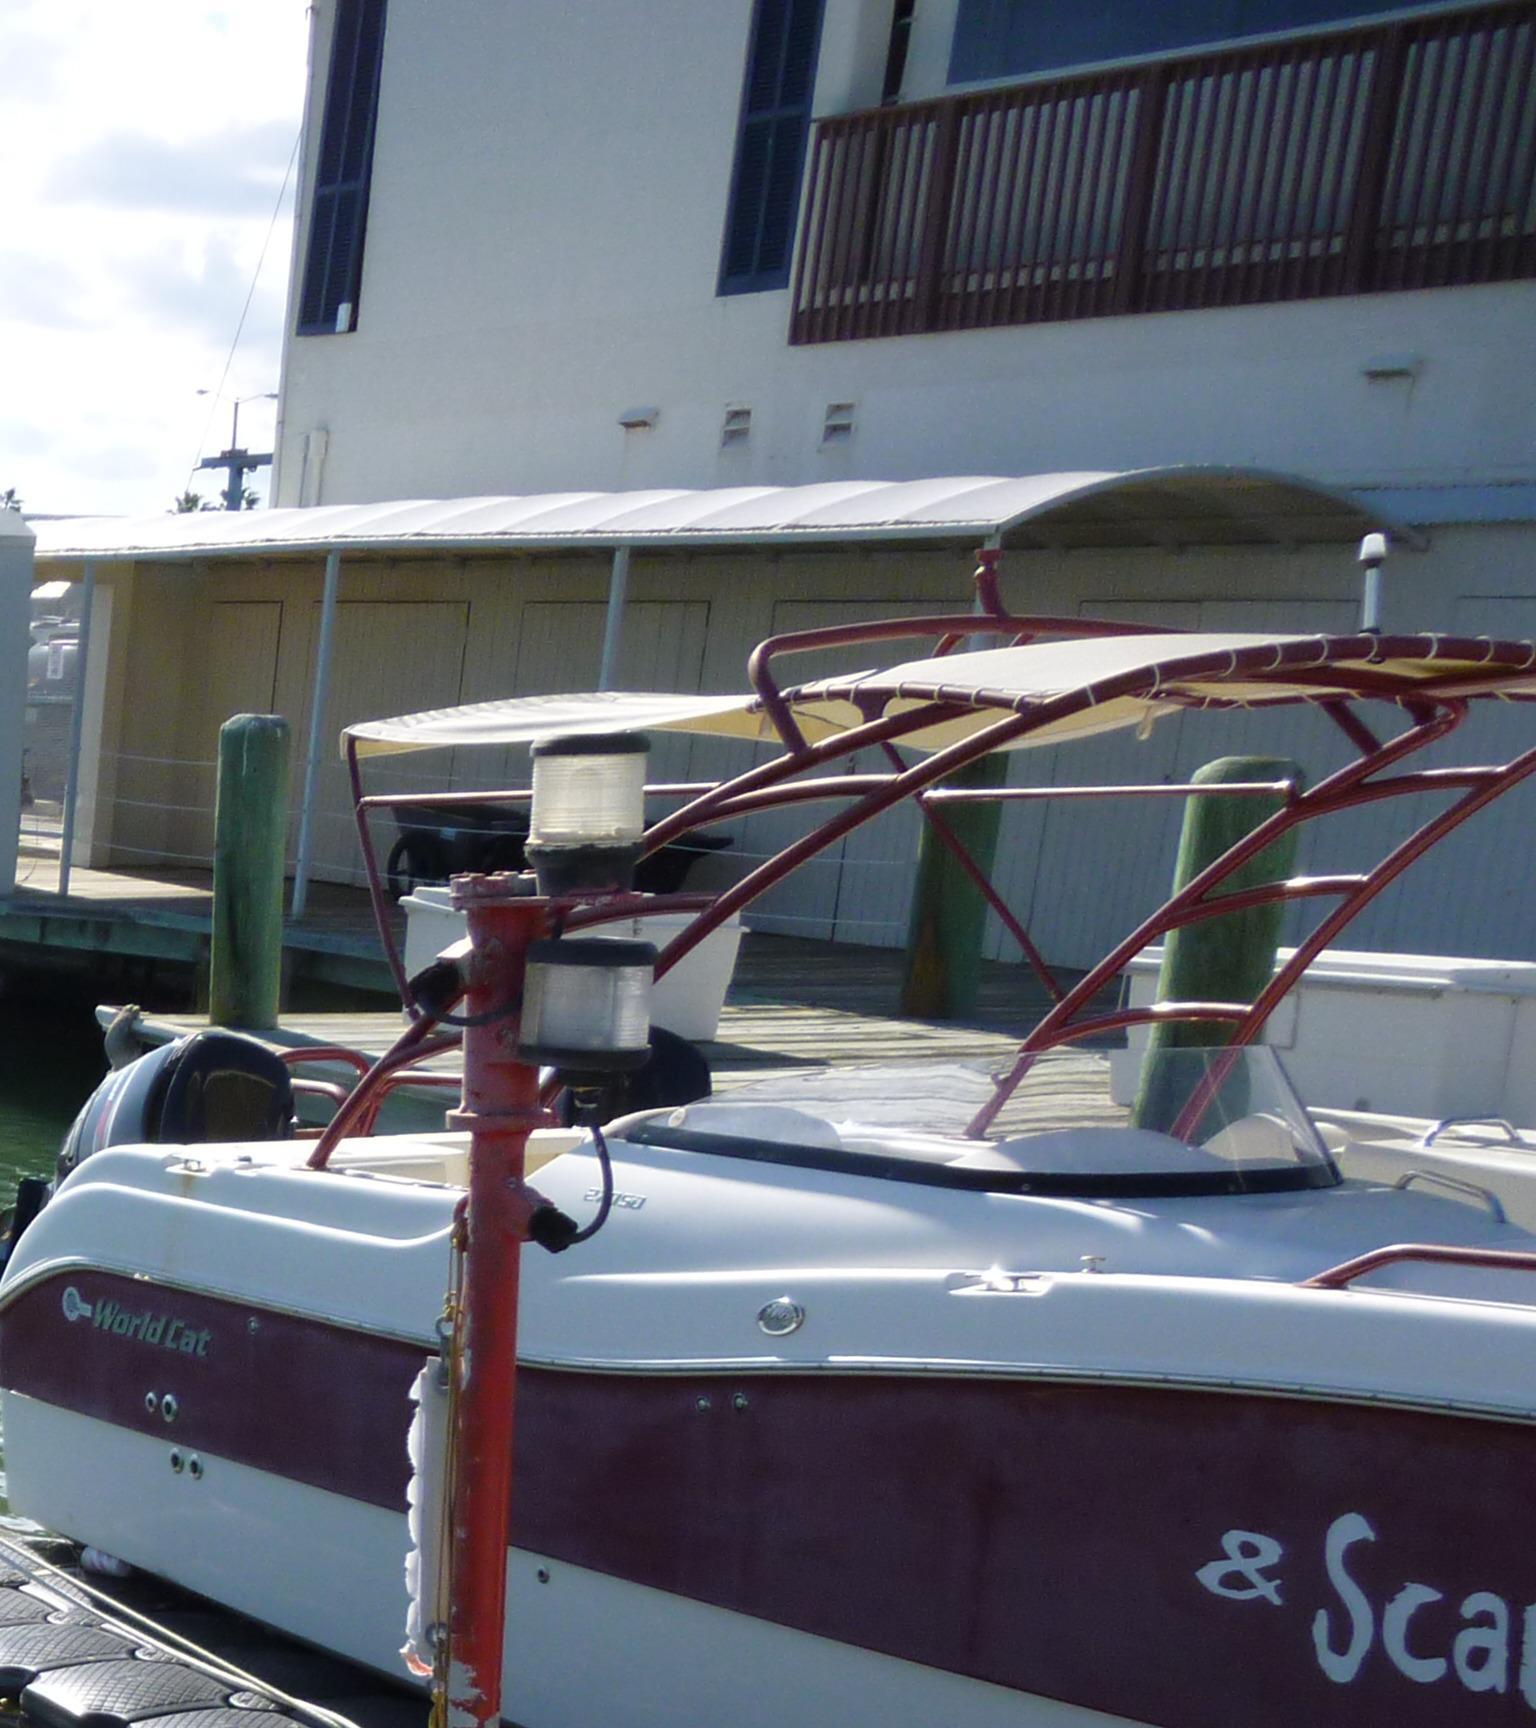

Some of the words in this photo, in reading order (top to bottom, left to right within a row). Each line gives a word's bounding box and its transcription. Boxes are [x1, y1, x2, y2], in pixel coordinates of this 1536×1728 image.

[93, 1299, 168, 1345] World
[163, 1315, 212, 1357] Cat
[1194, 1529, 1283, 1606] &
[1312, 1512, 1536, 1712] Sca
